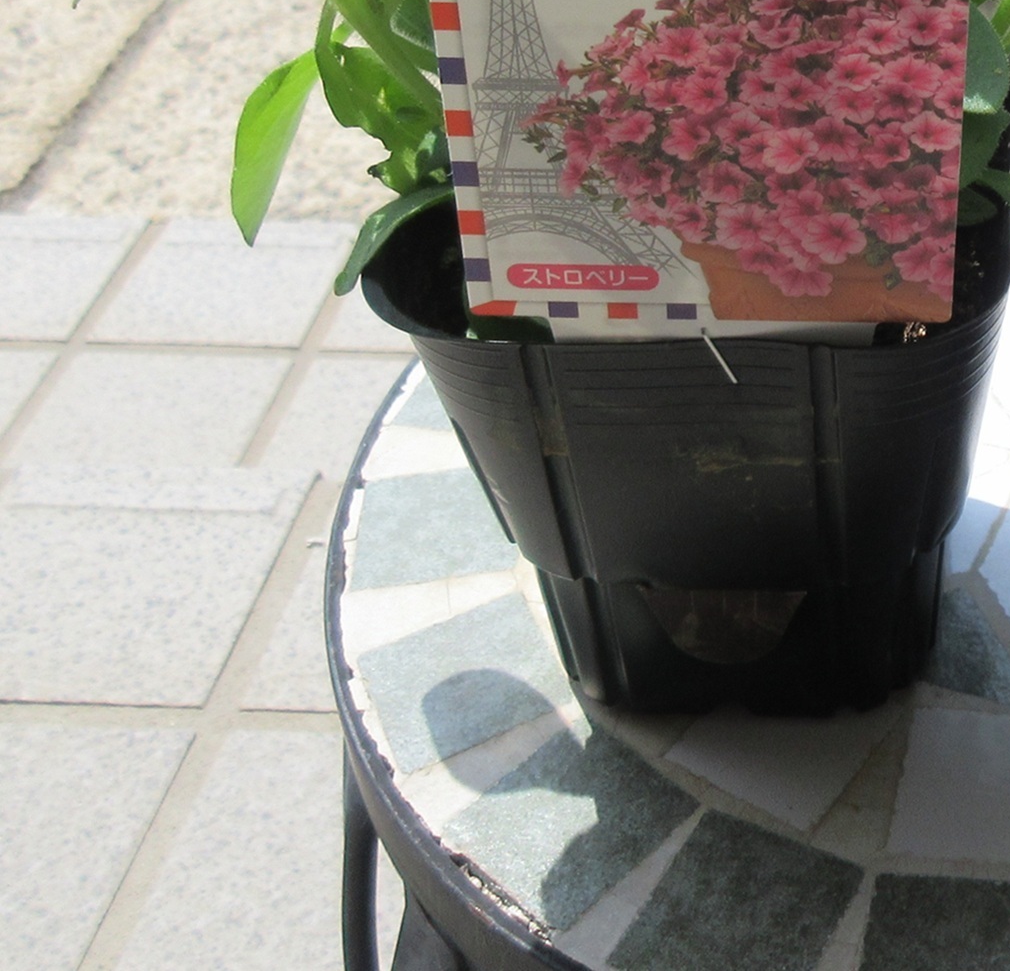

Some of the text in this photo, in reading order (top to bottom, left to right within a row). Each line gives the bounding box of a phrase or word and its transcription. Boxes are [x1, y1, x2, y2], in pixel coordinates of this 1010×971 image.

[523, 267, 649, 287] ストロベリー
